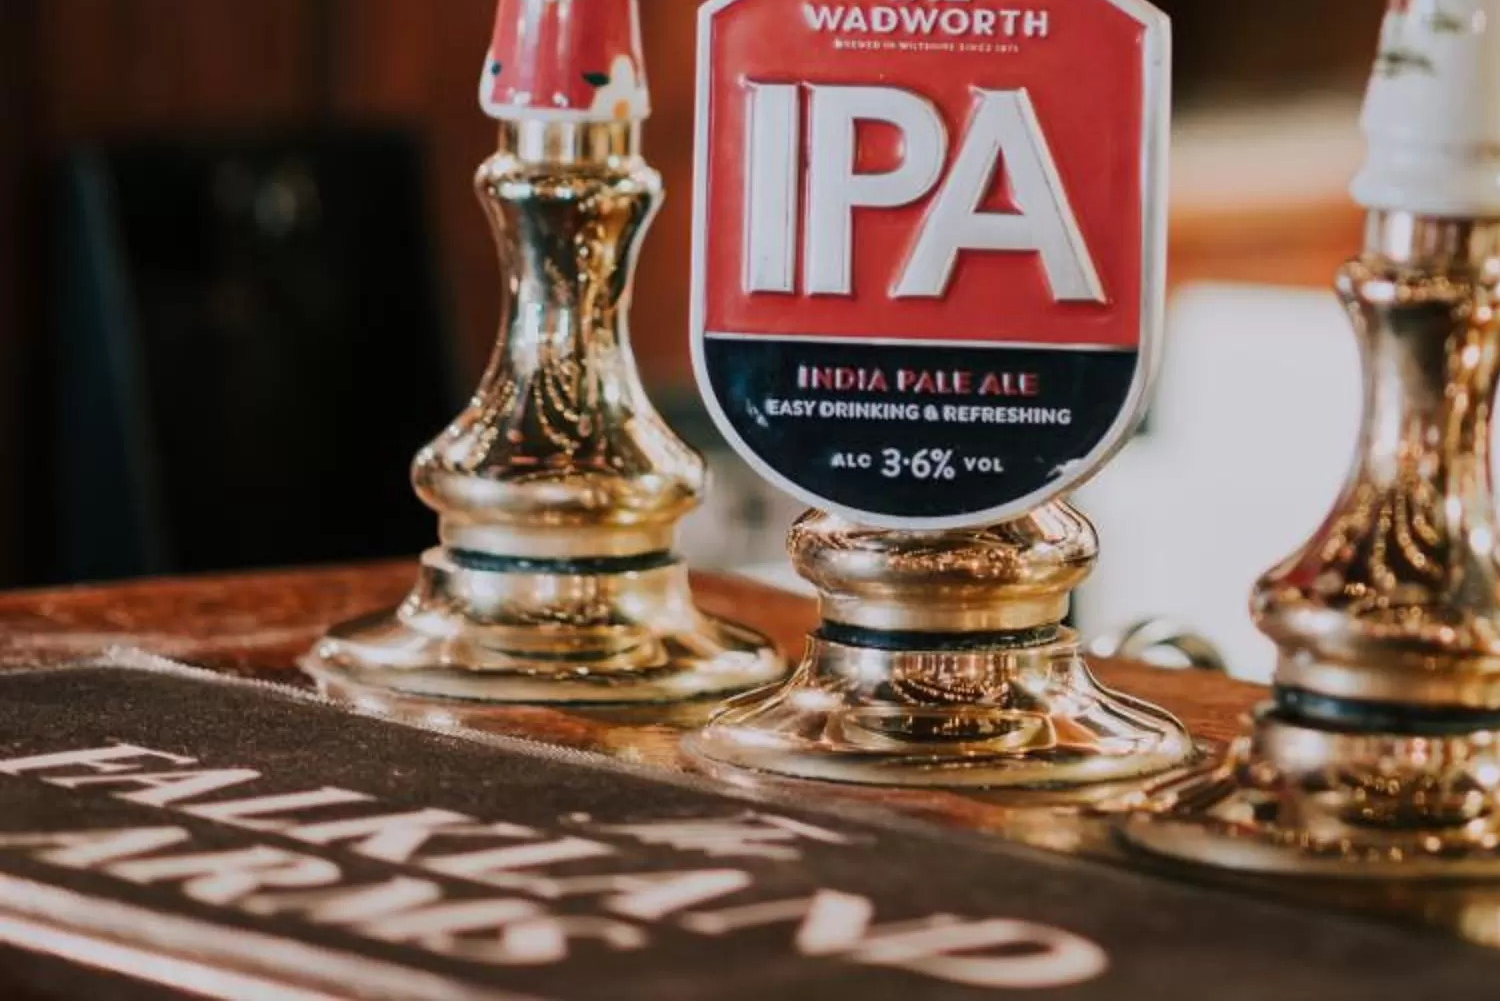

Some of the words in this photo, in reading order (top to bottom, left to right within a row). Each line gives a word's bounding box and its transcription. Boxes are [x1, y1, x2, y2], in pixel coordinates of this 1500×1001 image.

[802, 2, 1049, 38] WADWORTH
[738, 75, 1108, 305] IPA
[797, 365, 888, 392] INDIA
[897, 369, 972, 394] PALE
[978, 372, 1038, 396] ALE
[765, 399, 816, 418] EASY
[819, 402, 919, 421] DRINKING
[923, 405, 940, 421] &
[943, 406, 1072, 426] REFRESHING
[830, 452, 873, 469] ALC
[963, 457, 1004, 473] VOL
[0, 742, 1108, 987] FALKLAND
[0, 825, 648, 964] ARMS
